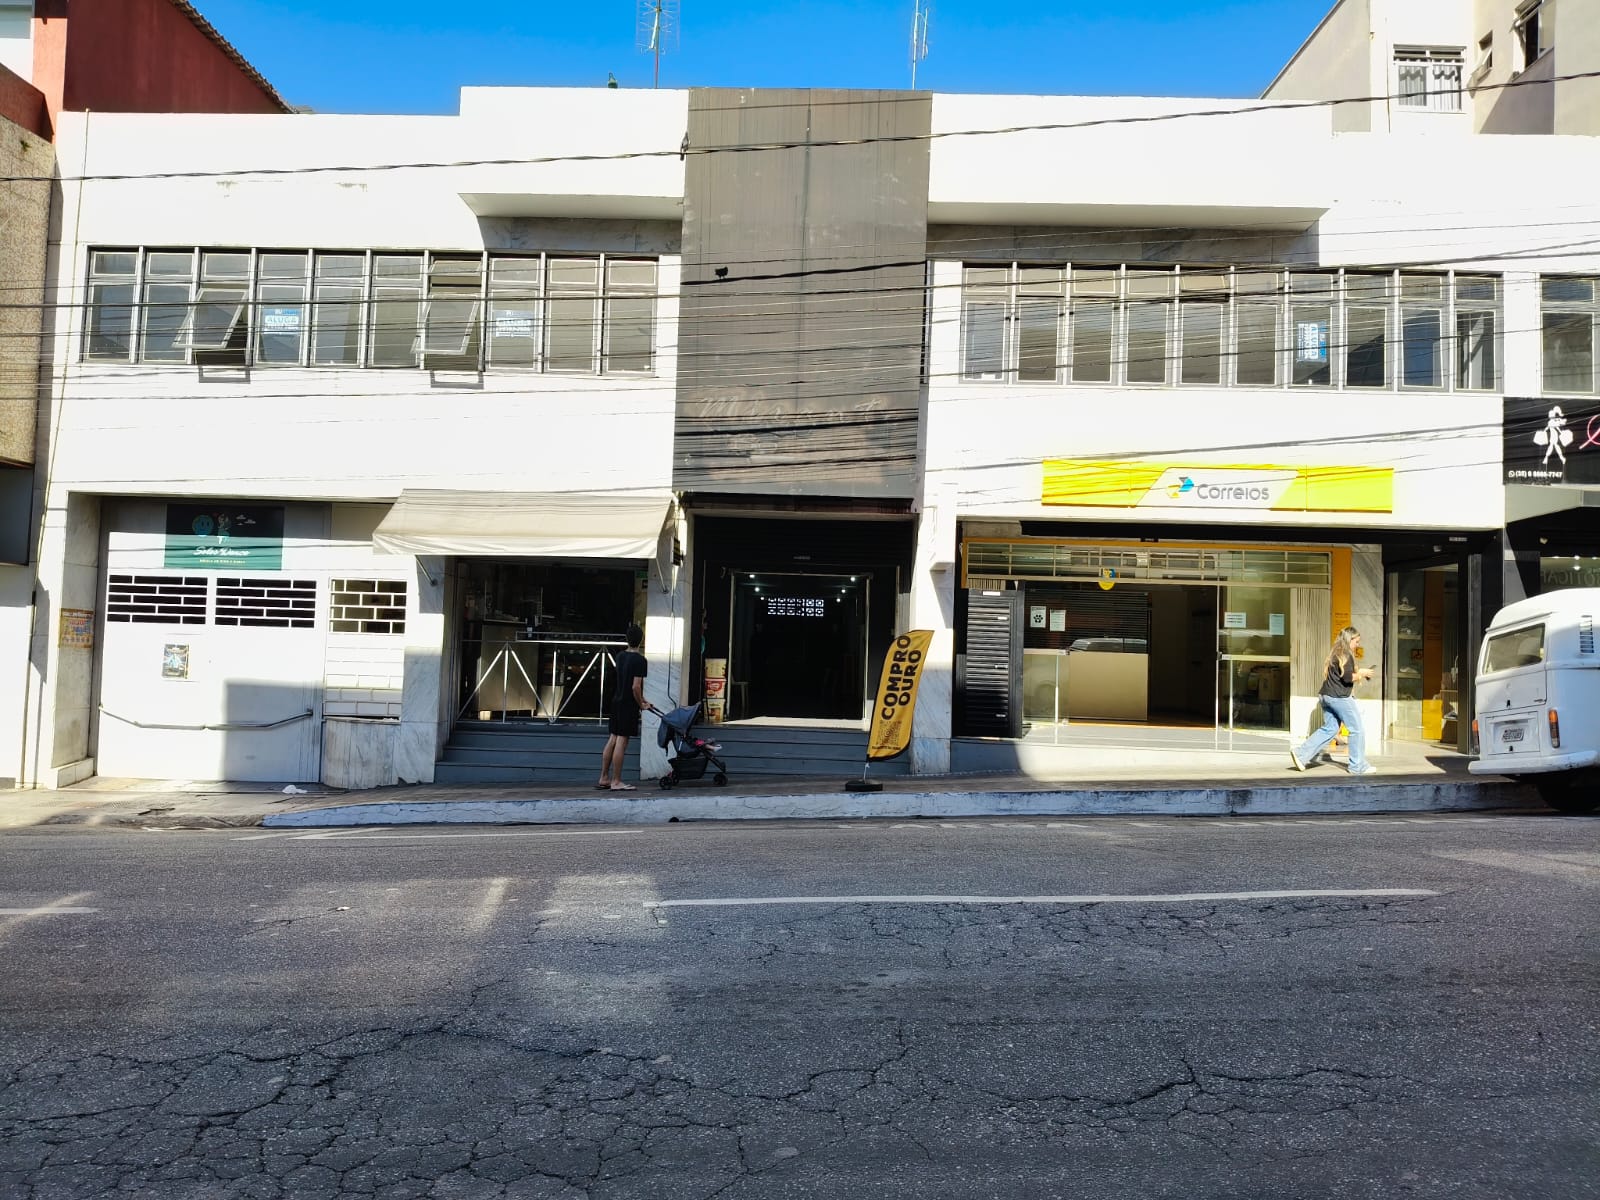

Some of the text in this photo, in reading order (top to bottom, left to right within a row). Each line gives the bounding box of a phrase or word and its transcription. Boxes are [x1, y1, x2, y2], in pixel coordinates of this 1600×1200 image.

[1196, 483, 1270, 501] Correios
[881, 635, 911, 720] COMPRO
[898, 649, 922, 706] OURO
